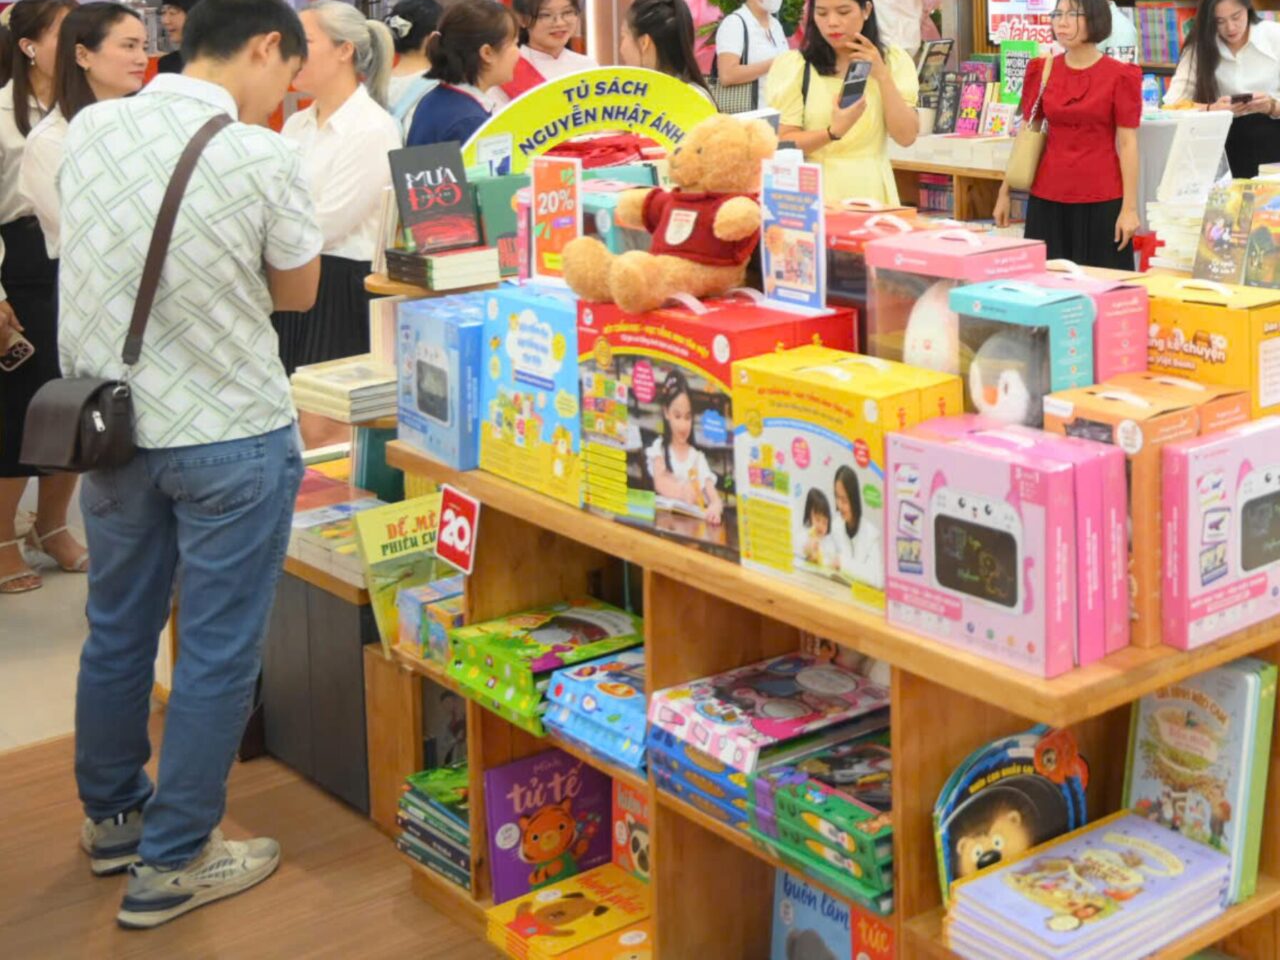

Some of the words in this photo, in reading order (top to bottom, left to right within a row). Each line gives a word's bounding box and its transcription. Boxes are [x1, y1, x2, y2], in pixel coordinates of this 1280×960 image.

[1009, 22, 1054, 43] fahasa
[563, 79, 590, 102] TỦ
[594, 77, 648, 97] SÁCH
[518, 104, 597, 156] NGUYỄN
[601, 102, 652, 128] NHẬT
[649, 112, 686, 145] ÁNH
[404, 166, 457, 189] MƯA
[538, 188, 575, 216] 20%
[1183, 341, 1226, 364] chuyện
[386, 515, 409, 540] DẾ
[412, 510, 437, 533] MÈ
[381, 535, 419, 557] PHIÊU
[506, 776, 547, 813] tử
[547, 760, 584, 803] tế
